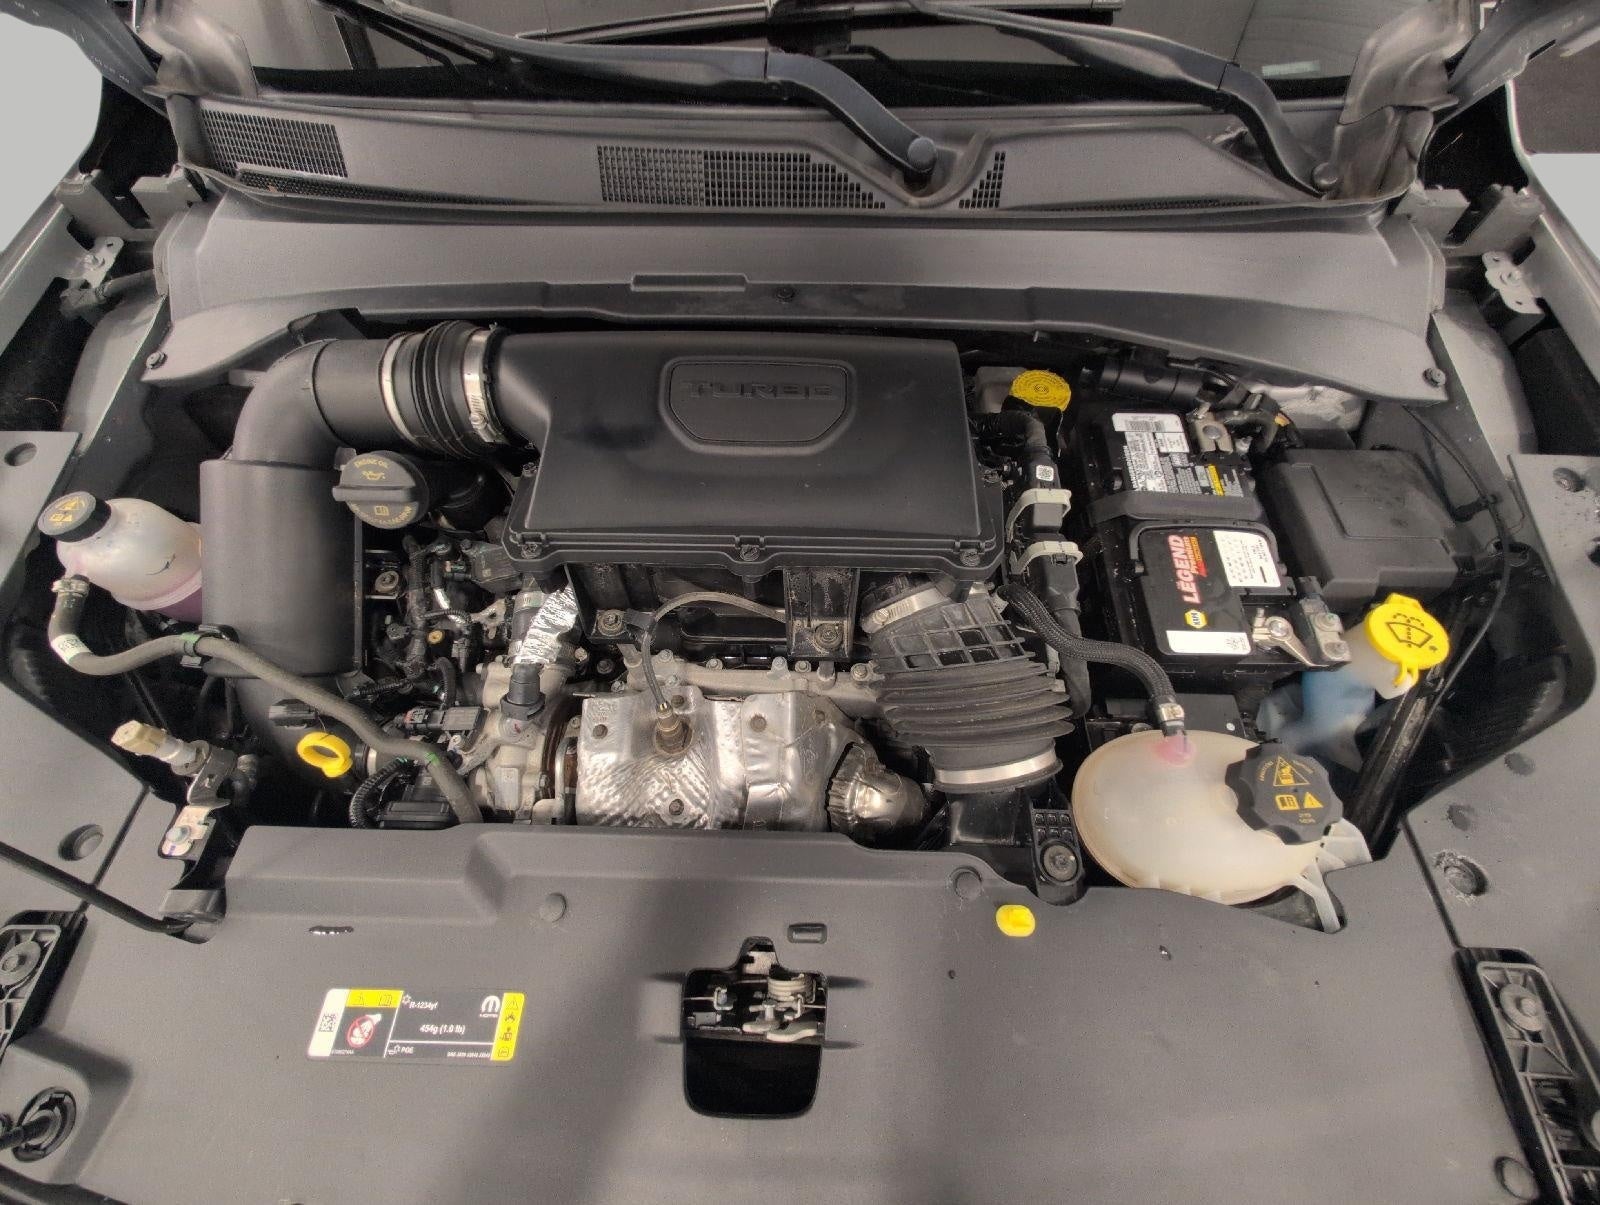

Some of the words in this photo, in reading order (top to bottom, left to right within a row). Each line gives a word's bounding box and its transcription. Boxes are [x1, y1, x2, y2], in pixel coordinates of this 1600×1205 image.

[1168, 534, 1201, 604] LEGEND
[409, 1000, 438, 1010] R-1234yf
[419, 1024, 438, 1035] 454g
[439, 1024, 454, 1035] (1.0
[455, 1024, 466, 1035] lb)
[401, 1046, 414, 1055] POE
